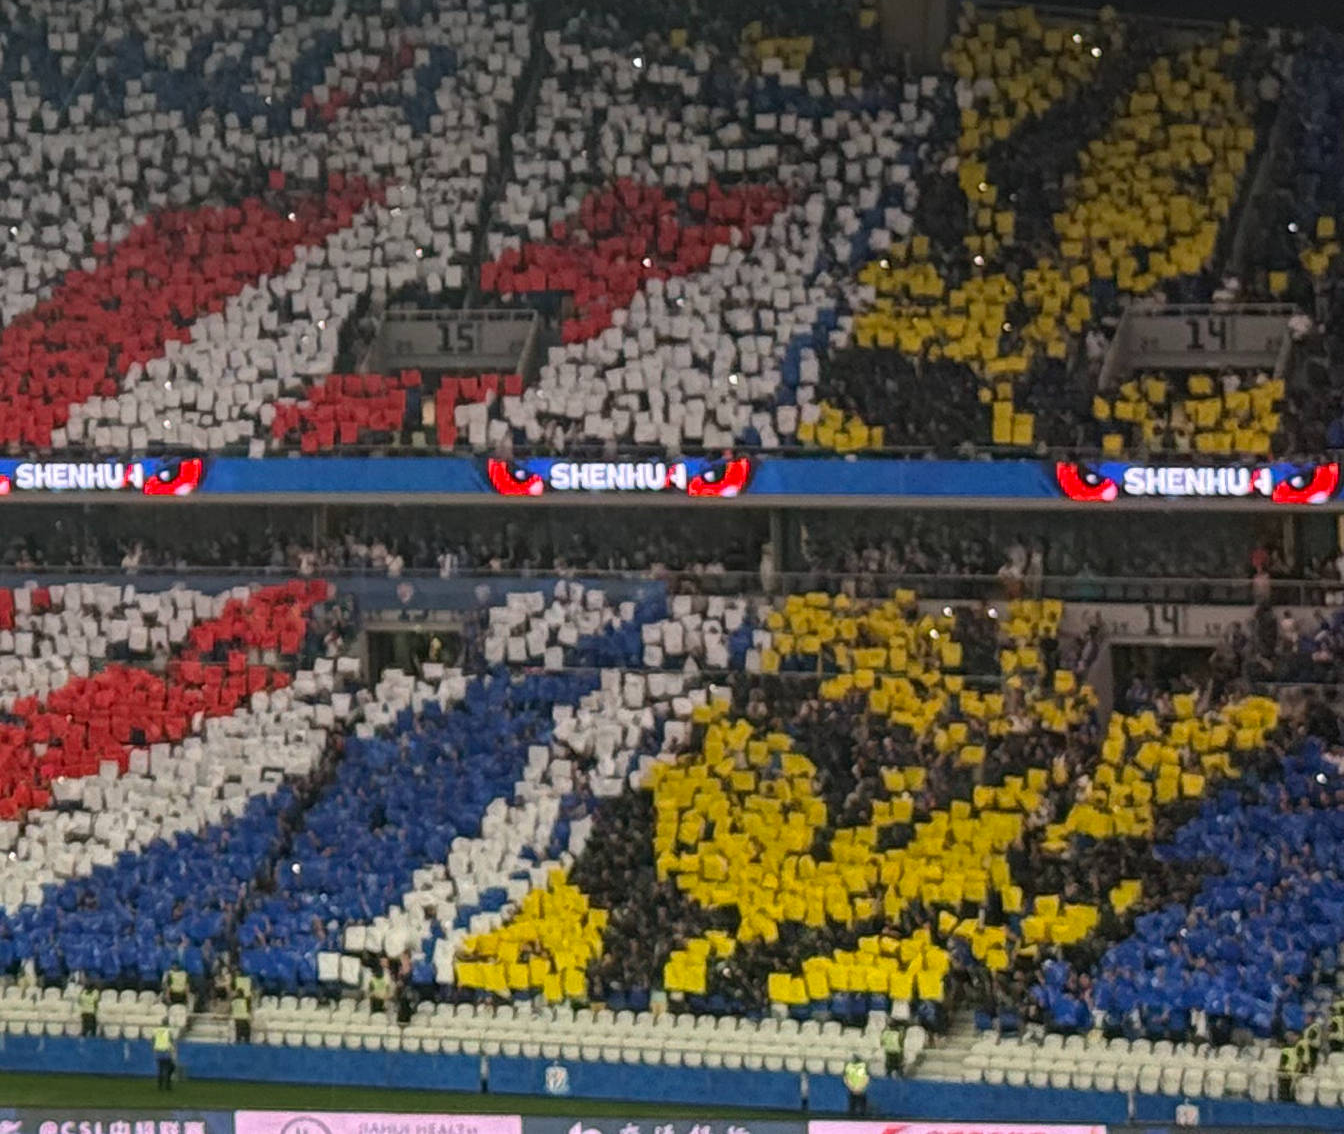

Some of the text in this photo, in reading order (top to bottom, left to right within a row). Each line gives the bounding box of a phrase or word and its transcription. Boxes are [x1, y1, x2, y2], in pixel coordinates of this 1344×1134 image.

[437, 323, 474, 353] 15
[1185, 318, 1226, 350] 14
[16, 463, 144, 488] SHENHUA
[549, 463, 688, 490] SHENHUA
[1124, 467, 1274, 496] SHENHUA
[1144, 604, 1180, 635] 14
